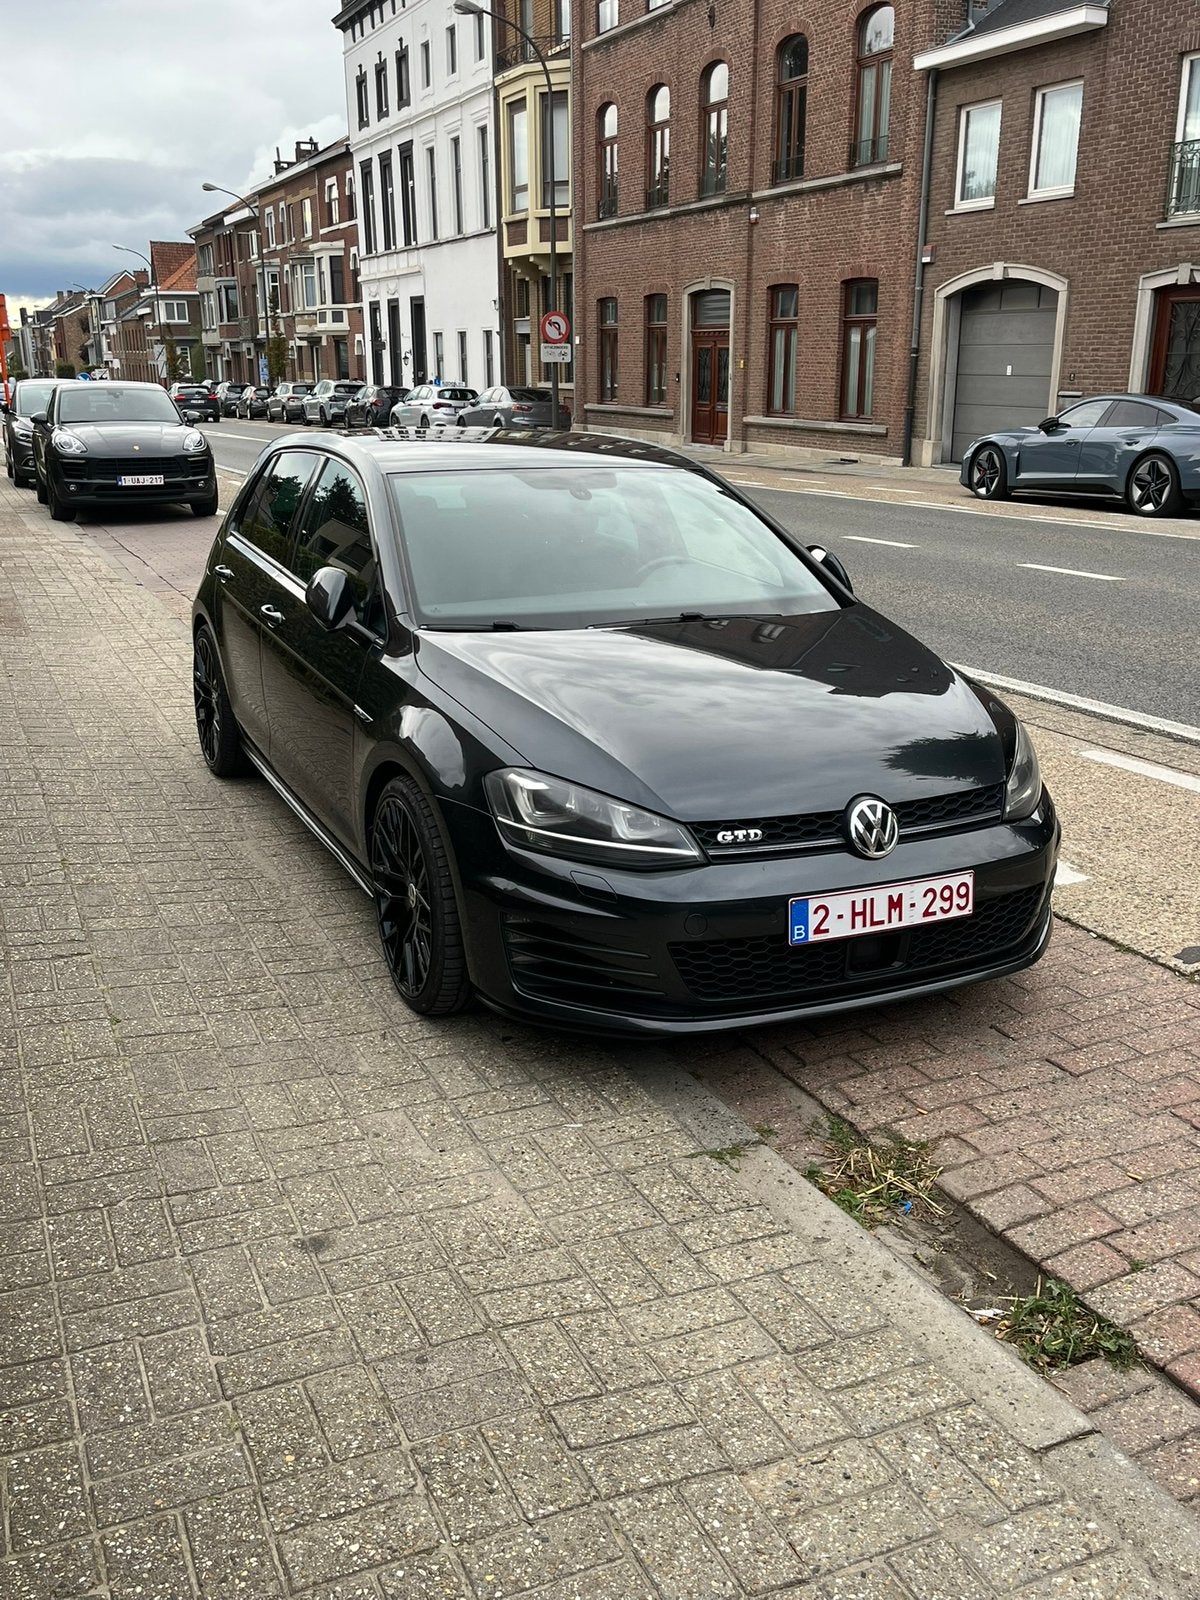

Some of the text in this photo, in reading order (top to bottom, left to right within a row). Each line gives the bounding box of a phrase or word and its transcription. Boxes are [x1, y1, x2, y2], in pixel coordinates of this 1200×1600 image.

[123, 476, 163, 484] 1-UAJ-217
[717, 828, 763, 844] GTD
[850, 799, 898, 858] VW
[794, 881, 970, 940] B 2-HLM-299
